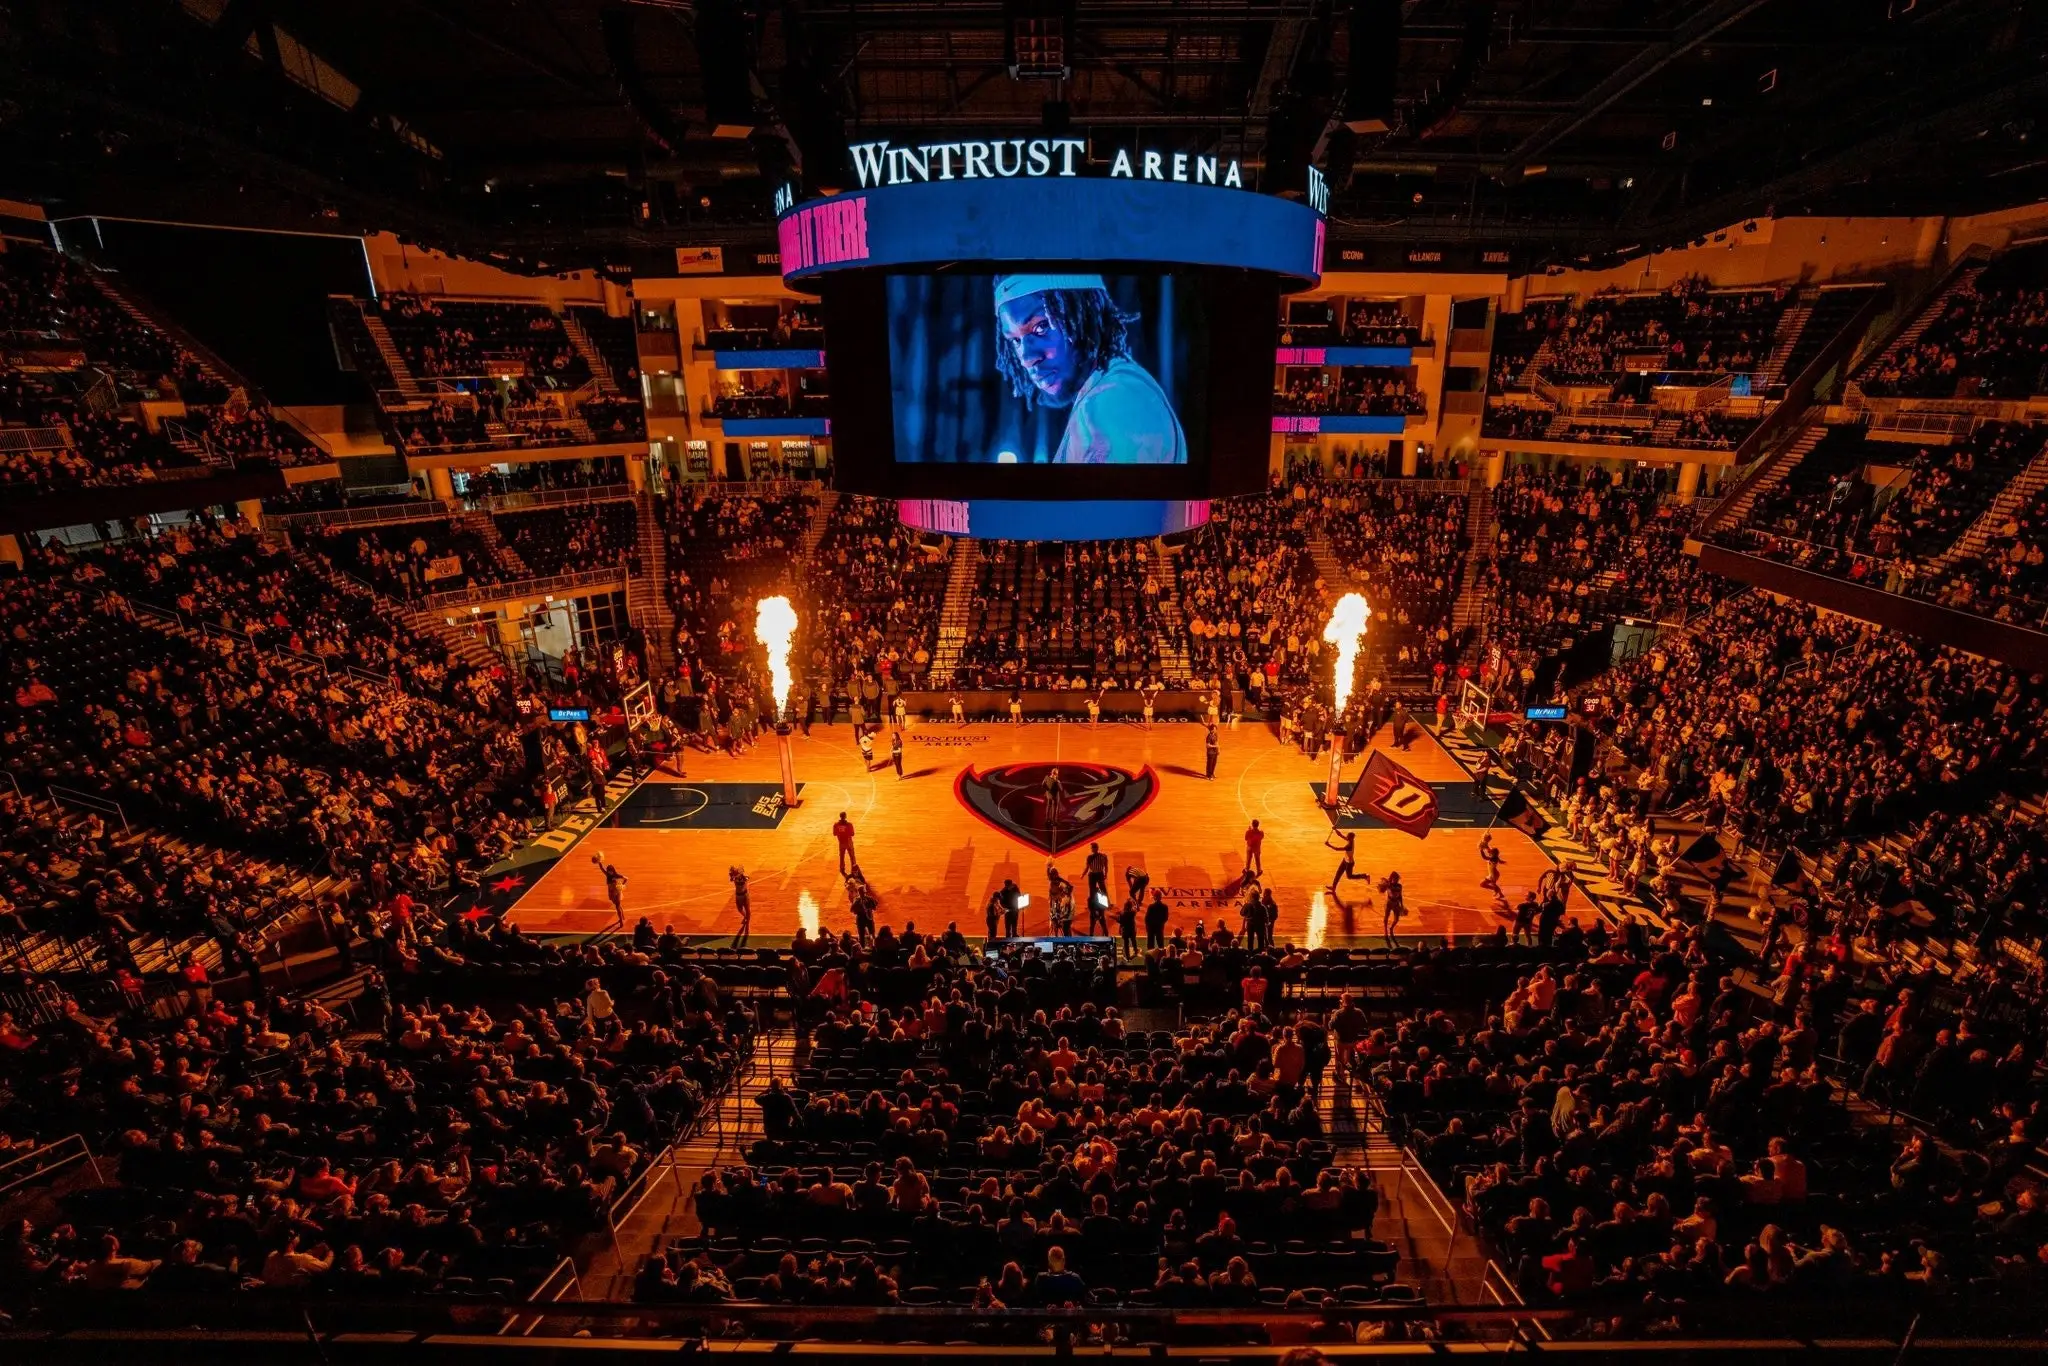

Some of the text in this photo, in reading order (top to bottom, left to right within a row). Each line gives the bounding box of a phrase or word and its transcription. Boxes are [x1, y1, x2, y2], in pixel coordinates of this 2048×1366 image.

[849, 140, 1242, 189] WINTRUST ARENA
[813, 196, 870, 265] THERE
[757, 253, 781, 264] BUTLE
[1408, 250, 1442, 263] VILLANOVA
[932, 499, 970, 534] THERE
[1175, 900, 1244, 908] ARENA
